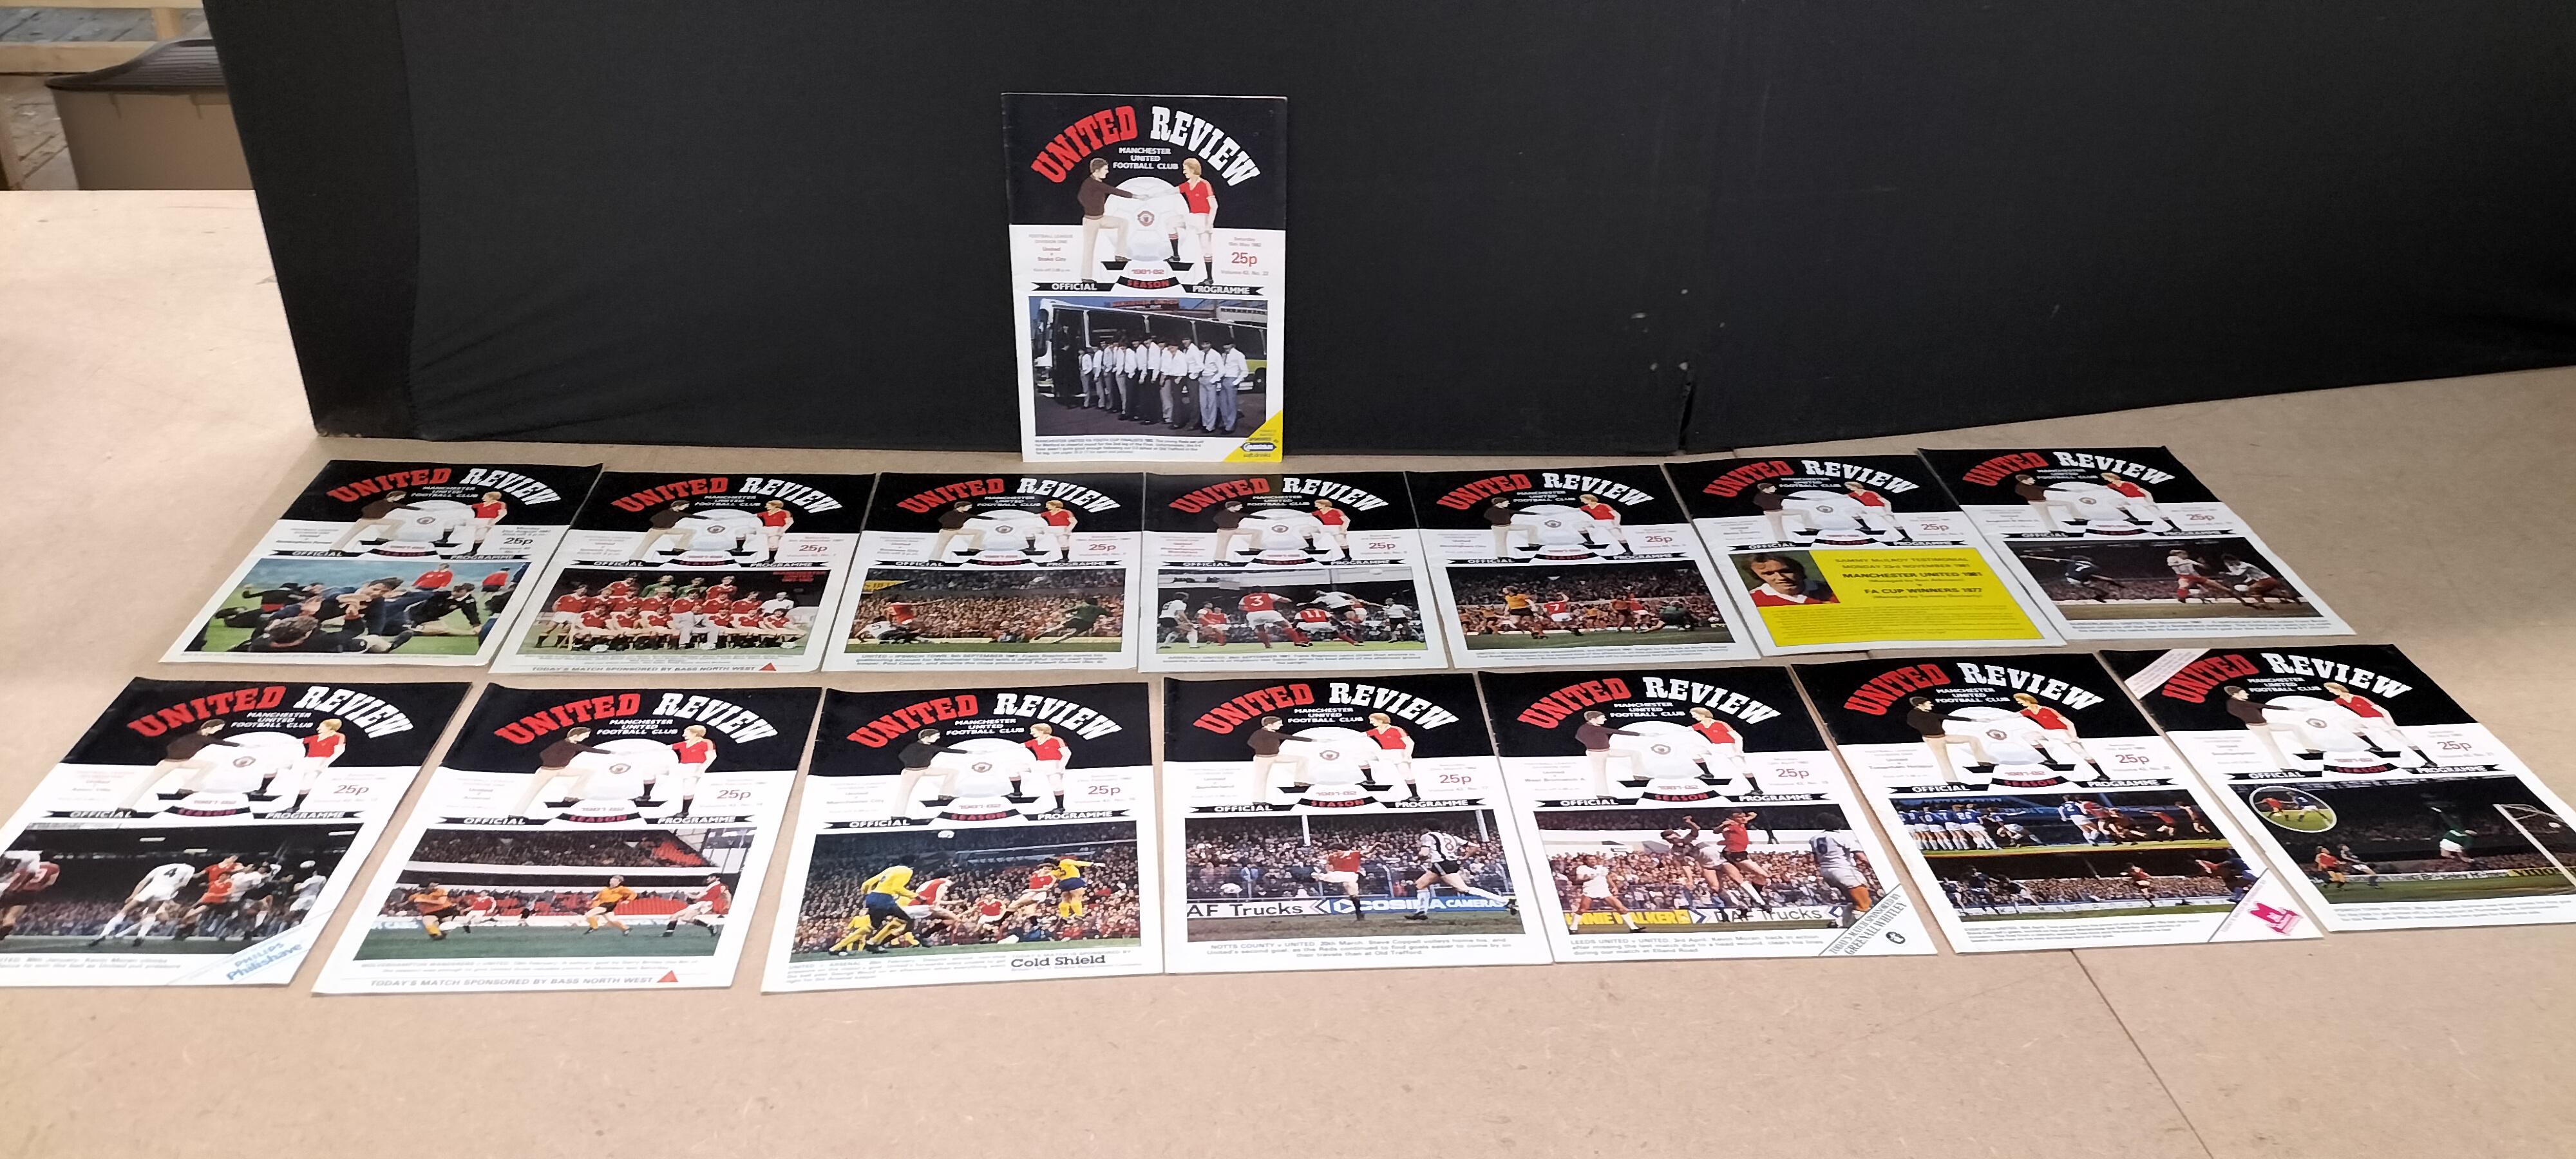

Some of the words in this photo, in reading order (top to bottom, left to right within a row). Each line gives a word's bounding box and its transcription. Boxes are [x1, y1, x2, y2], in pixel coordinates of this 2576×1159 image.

[1030, 105, 1138, 183] UNITED
[1150, 106, 1261, 190] REVIEW
[1232, 252, 1257, 267] 25p
[1126, 279, 1170, 288] SEASON
[1192, 285, 1250, 294] PROGRAMME
[1962, 452, 2048, 485] UNITED
[2052, 451, 2175, 484] REVIEW
[1702, 460, 1794, 497] UNITED
[1801, 460, 1920, 495] REVIEW
[327, 468, 451, 502] UNITED
[459, 468, 562, 505] REVIEW
[1435, 473, 1531, 510] UNITED
[1542, 473, 1654, 506] REVIEW
[611, 477, 728, 511] UNITED
[739, 477, 843, 513] REVIEW
[896, 478, 1005, 513] UNITED
[1016, 478, 1121, 513] REVIEW
[1169, 478, 1271, 513] UNITED
[1282, 477, 1389, 511] REVIEW
[504, 534, 533, 545] 25p
[1249, 596, 1264, 607] 3
[1304, 610, 1321, 618] 11
[2161, 654, 2259, 703] UNITED
[2260, 652, 2413, 699] REVIEW
[1842, 664, 1951, 715] UNITED
[1956, 663, 2105, 710] REVIEW
[1951, 691, 1988, 699] UNITED
[1517, 677, 1631, 728] UNITED
[1642, 677, 1781, 724] REVIEW
[126, 686, 287, 737] UNITED
[292, 686, 414, 739] REVIEW
[1192, 683, 1314, 734] UNITED
[1329, 683, 1459, 730] REVIEW
[493, 693, 641, 744] UNITED
[651, 692, 778, 744] REVIEW
[846, 695, 978, 748] UNITED
[993, 693, 1122, 740] REVIEW
[954, 718, 1016, 726] MANCHESTER
[967, 722, 1005, 731] UNITED
[999, 726, 1025, 734] CLUB
[2438, 741, 2472, 751] 25p
[2116, 755, 2149, 764] 25p
[1776, 769, 1809, 778] 25p
[2415, 765, 2487, 773] PROGRAMME
[1439, 775, 1471, 784] 25p
[2247, 770, 2306, 779] OFFICIAL
[2003, 778, 2060, 786] SEASON
[2086, 778, 2161, 787] PROGRAMME
[334, 786, 368, 795] 25p
[1088, 786, 1121, 795] 25p
[1909, 784, 1972, 793] OFFICIAL
[717, 790, 751, 800] 25p
[1654, 792, 1709, 802] SEASON
[1738, 792, 1813, 802] PROGRAMME
[1311, 798, 1365, 807] SEASON
[1394, 798, 1470, 808] PROGRAMME
[1558, 798, 1620, 807] OFFICIAL
[1213, 804, 1274, 813] OFFICIAL
[69, 810, 132, 818] OFFICIAL
[265, 811, 346, 819] PROGRAMME
[951, 812, 1008, 821] SEASON
[1036, 811, 1114, 820] PROGRAMME
[462, 816, 527, 825] OFFICIAL
[848, 818, 911, 827] OFFICIAL
[1443, 837, 1455, 851] 8
[1815, 836, 1828, 854] 6
[164, 867, 178, 878] 4
[1230, 903, 1303, 916] Trucks
[1758, 908, 1823, 920] Trucks
[1849, 920, 1870, 938] MATCH
[1865, 898, 1895, 923] SPONSORED
[1844, 923, 1881, 956] GREENALL
[1873, 901, 1908, 928] WHITLEY
[1010, 957, 1050, 968] Cold
[1054, 954, 1106, 966] Shield
